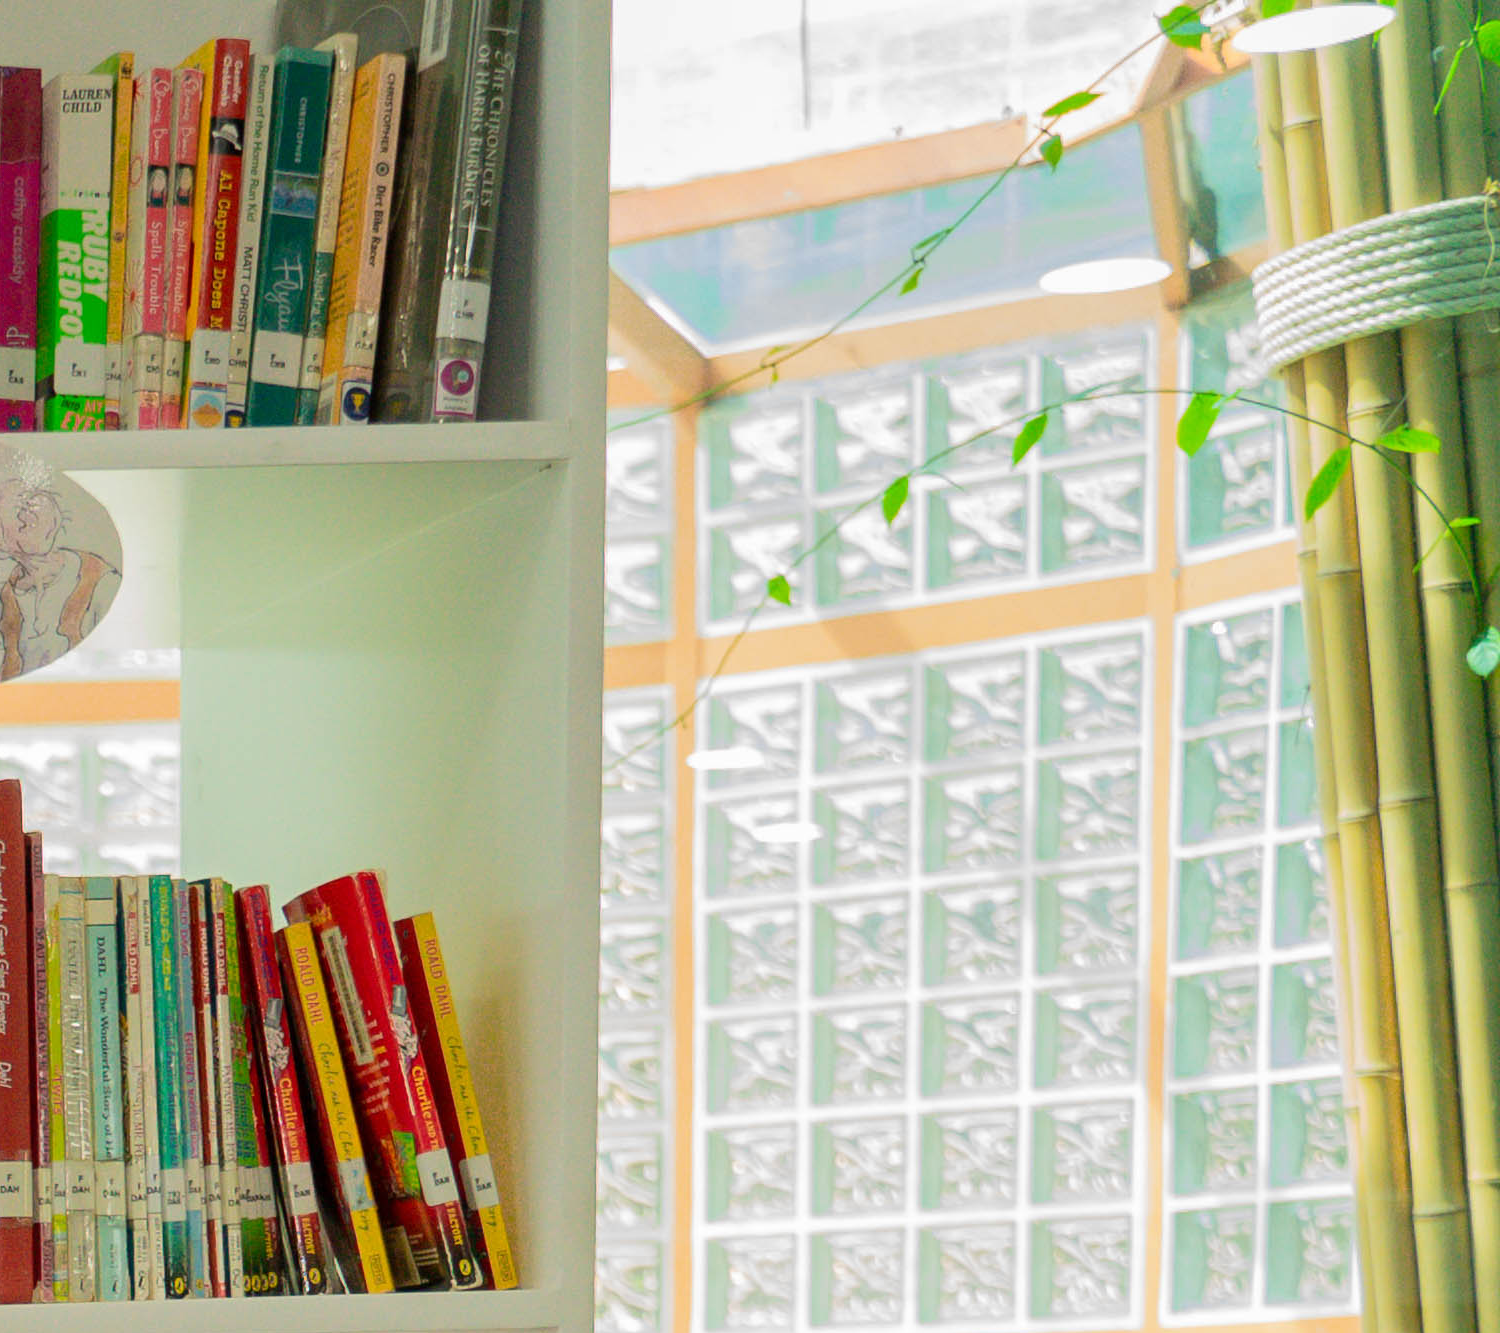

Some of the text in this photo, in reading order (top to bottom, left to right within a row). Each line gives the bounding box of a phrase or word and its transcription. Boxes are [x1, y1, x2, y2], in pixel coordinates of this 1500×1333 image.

[61, 89, 112, 100] LAUREN
[62, 102, 102, 114] CHILD
[380, 73, 395, 153] CHRISTOPHER
[471, 68, 486, 133] HARRIS
[463, 136, 480, 210] BURDICK
[82, 209, 109, 304] RUBY
[366, 186, 386, 268] Dirt Bike Racer
